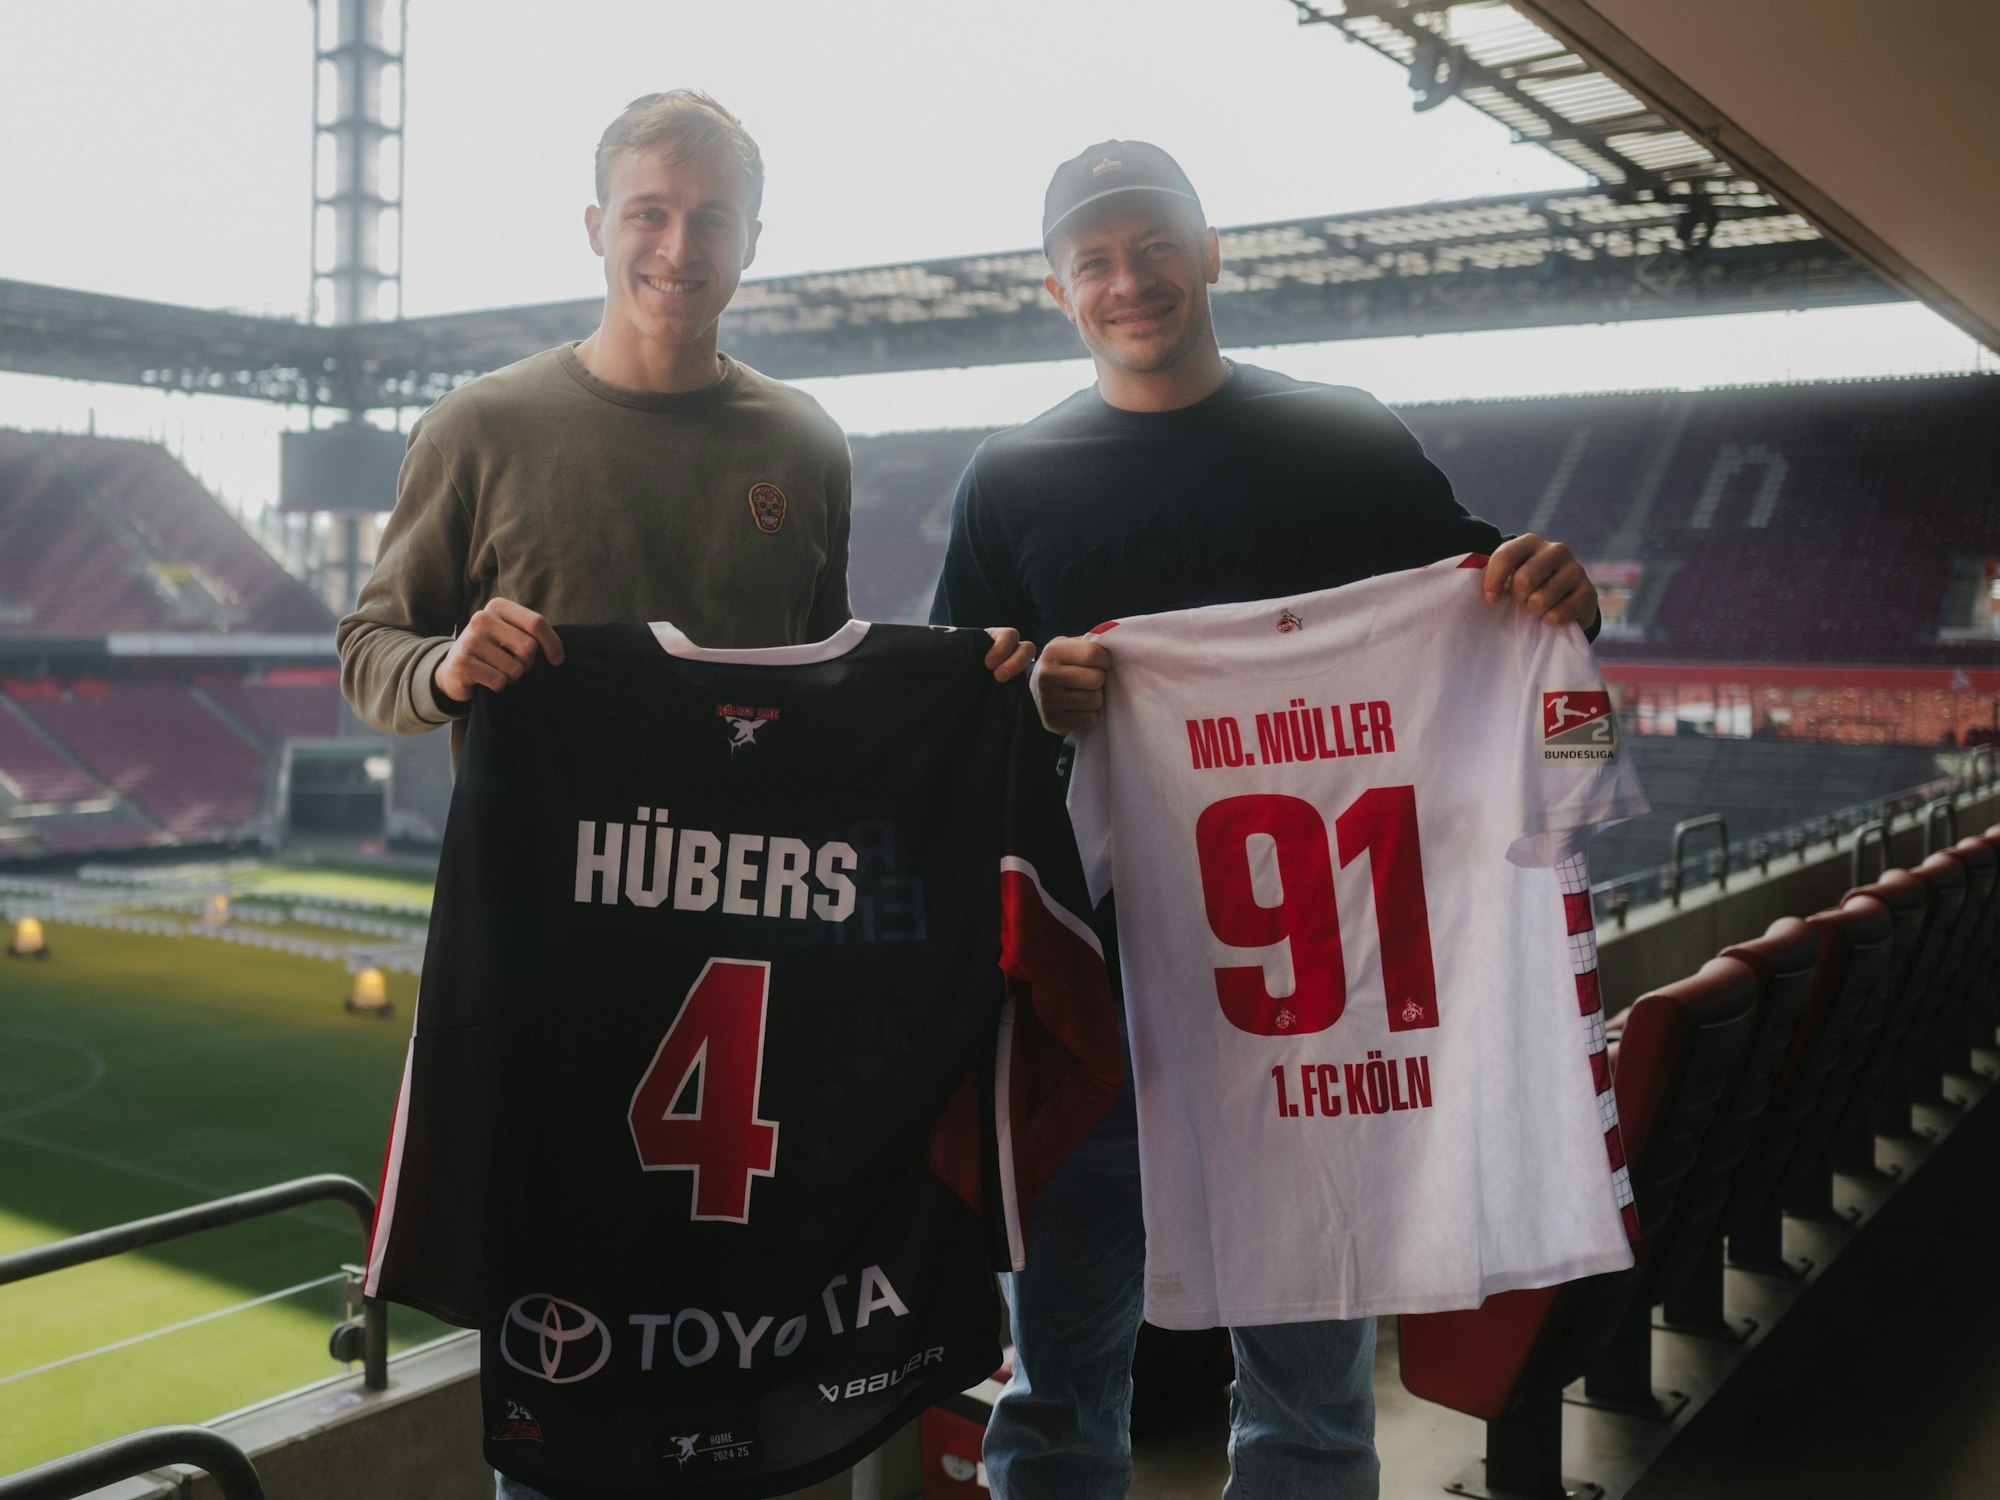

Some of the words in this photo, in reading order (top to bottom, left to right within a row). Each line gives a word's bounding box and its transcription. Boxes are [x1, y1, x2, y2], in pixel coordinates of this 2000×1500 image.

[1544, 750, 1614, 759] BUNDESLIGA
[1591, 718, 1610, 741] 2
[575, 806, 858, 923] HÜBERS
[1196, 785, 1440, 1036] 91
[627, 957, 780, 1225] 4
[1343, 1050, 1433, 1115] KÖLN
[709, 1432, 733, 1445] HOME
